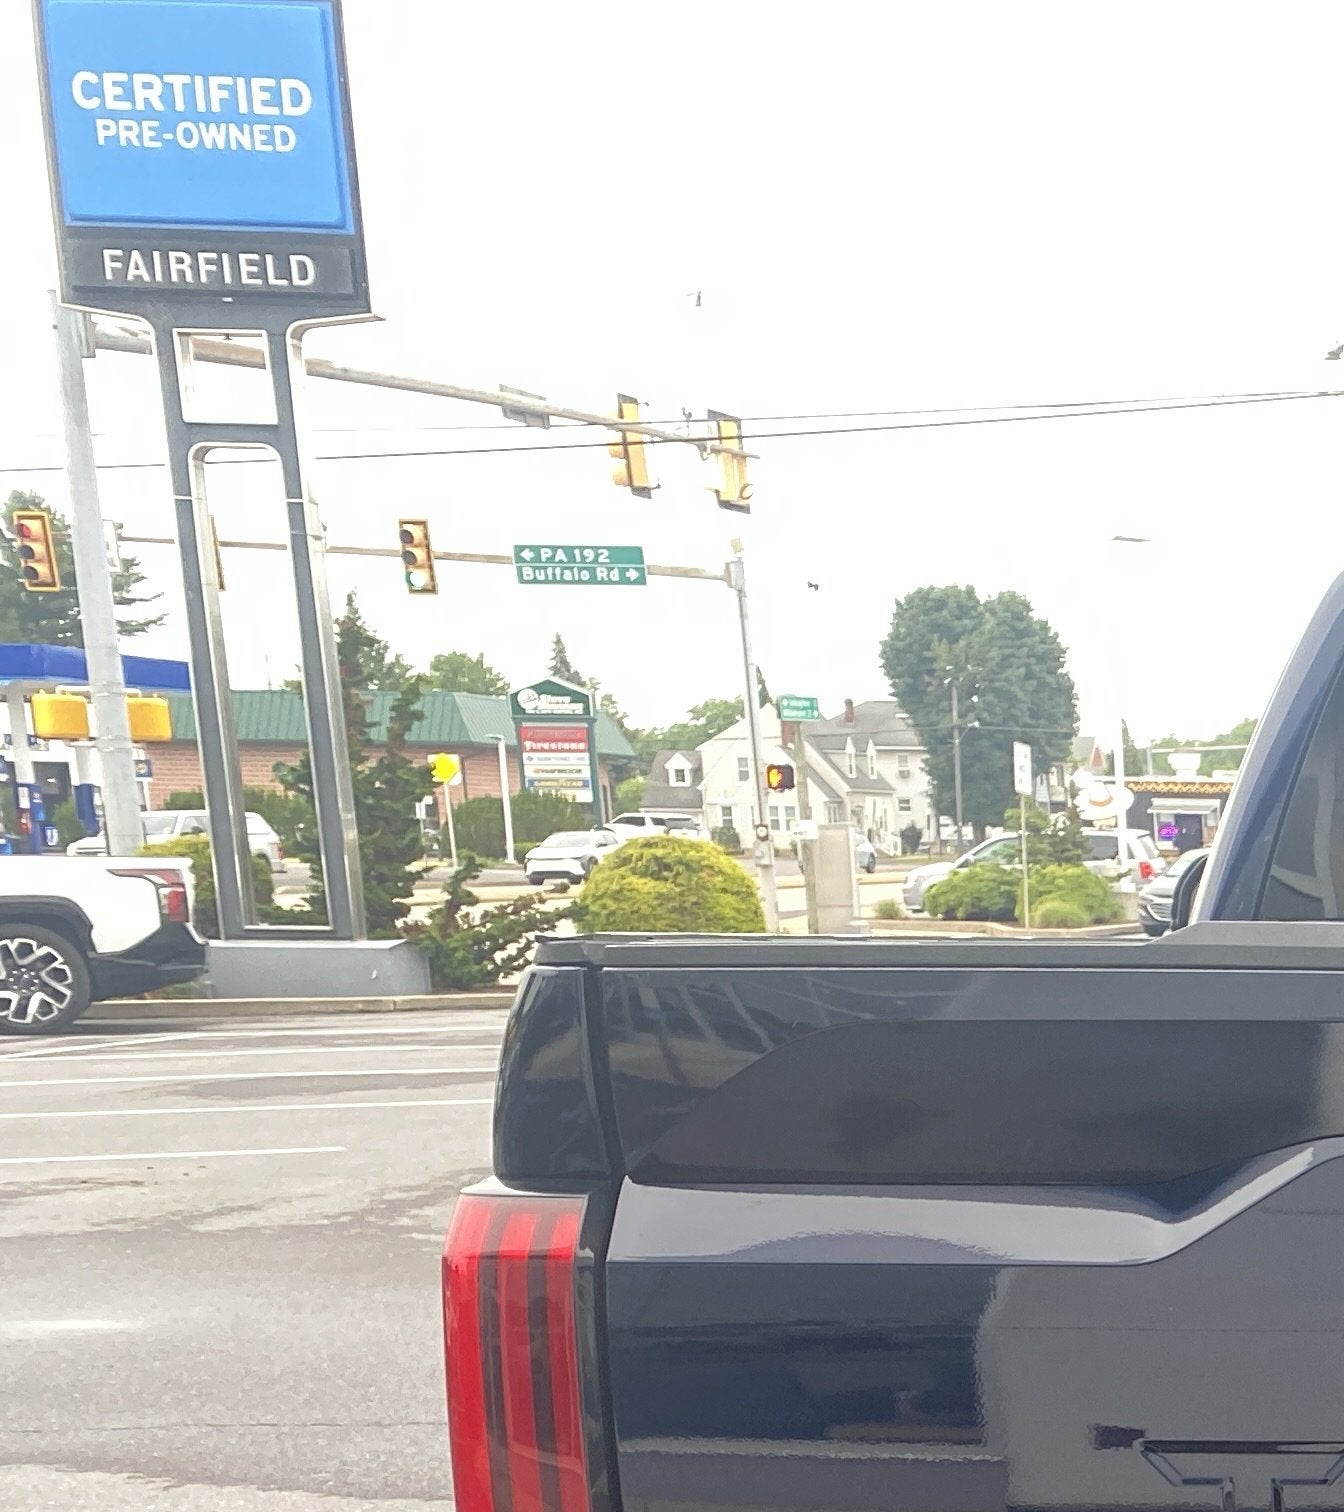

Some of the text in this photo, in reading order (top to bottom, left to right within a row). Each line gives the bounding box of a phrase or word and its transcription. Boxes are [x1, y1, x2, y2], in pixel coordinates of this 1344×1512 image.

[71, 71, 312, 116] CERTIFIED
[95, 118, 297, 152] PRE-OWNED
[102, 248, 317, 287] FAIRFIELD
[540, 547, 610, 563] PA 192
[521, 566, 620, 581] Buffalo Rd
